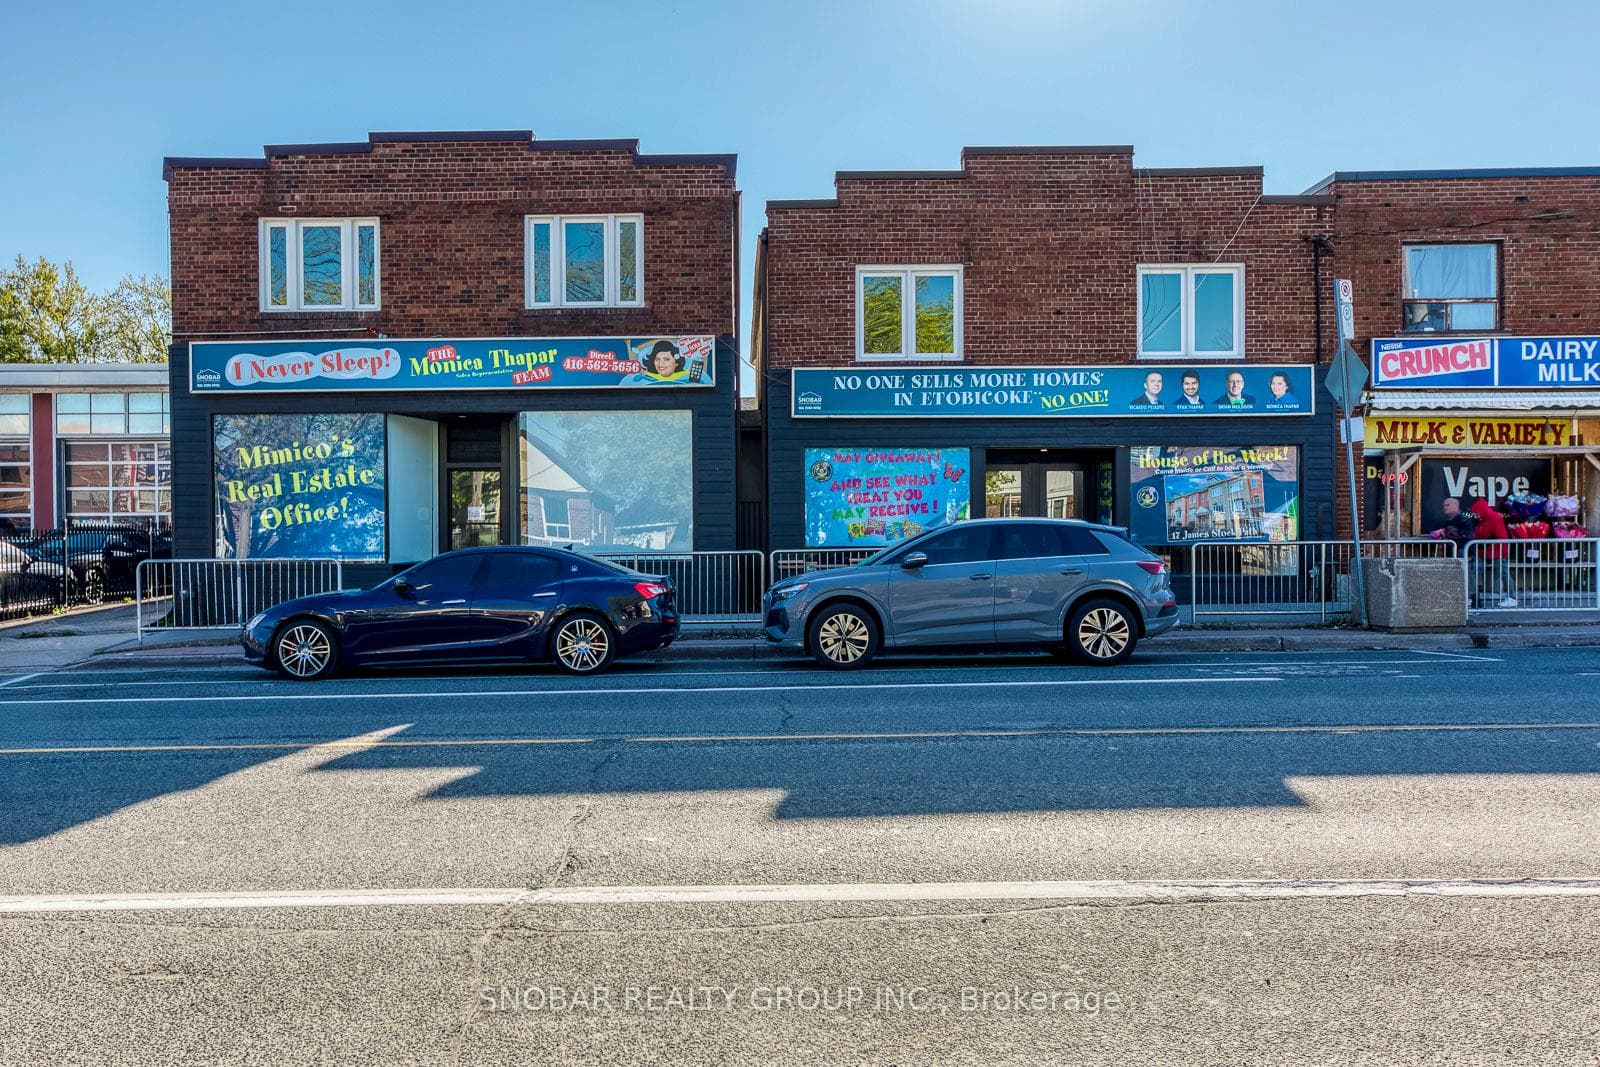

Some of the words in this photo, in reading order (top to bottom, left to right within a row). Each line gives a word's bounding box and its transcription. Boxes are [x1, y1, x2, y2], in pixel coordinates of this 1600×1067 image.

[428, 348, 455, 361] THE
[589, 352, 614, 360] Direct:
[1380, 342, 1487, 378] CRUNCH
[1521, 341, 1598, 361] DAIRY
[233, 362, 242, 380] I
[250, 359, 314, 380] Never
[321, 349, 391, 376] Sleep!
[409, 355, 483, 376] Monica
[488, 349, 558, 371] Thapar
[563, 359, 640, 373] 416-562-5656
[513, 368, 550, 384] TEAM
[833, 375, 862, 390] NO
[866, 375, 905, 389] ONE
[911, 374, 964, 388] SELLS
[970, 373, 1027, 387] MORE
[1538, 363, 1600, 382] MILK
[894, 392, 913, 406] IN
[1041, 395, 1065, 409] NO
[1069, 390, 1109, 406] ONE!
[1375, 420, 1448, 444] MILK
[1451, 425, 1465, 444] &
[1469, 422, 1566, 446] VARIETY
[236, 435, 355, 470] Mimico's
[833, 453, 862, 463] MAY
[865, 451, 941, 463] GIVEAWAY!
[1139, 453, 1189, 469] House
[1192, 450, 1210, 466] of
[1213, 449, 1237, 464] the
[1240, 447, 1289, 464] Week!
[224, 473, 283, 503] Real
[289, 465, 375, 494] Estate
[830, 477, 862, 492] AND
[866, 476, 890, 490] SEE
[894, 473, 937, 486] WHAT
[1443, 466, 1530, 507] Vape
[847, 490, 890, 505] TREAT
[892, 488, 923, 501] YOU
[259, 497, 349, 530] Office!
[832, 507, 865, 520] MAY
[869, 502, 929, 518] RECEIVE
[1172, 532, 1181, 540] 17
[1182, 530, 1210, 540] James
